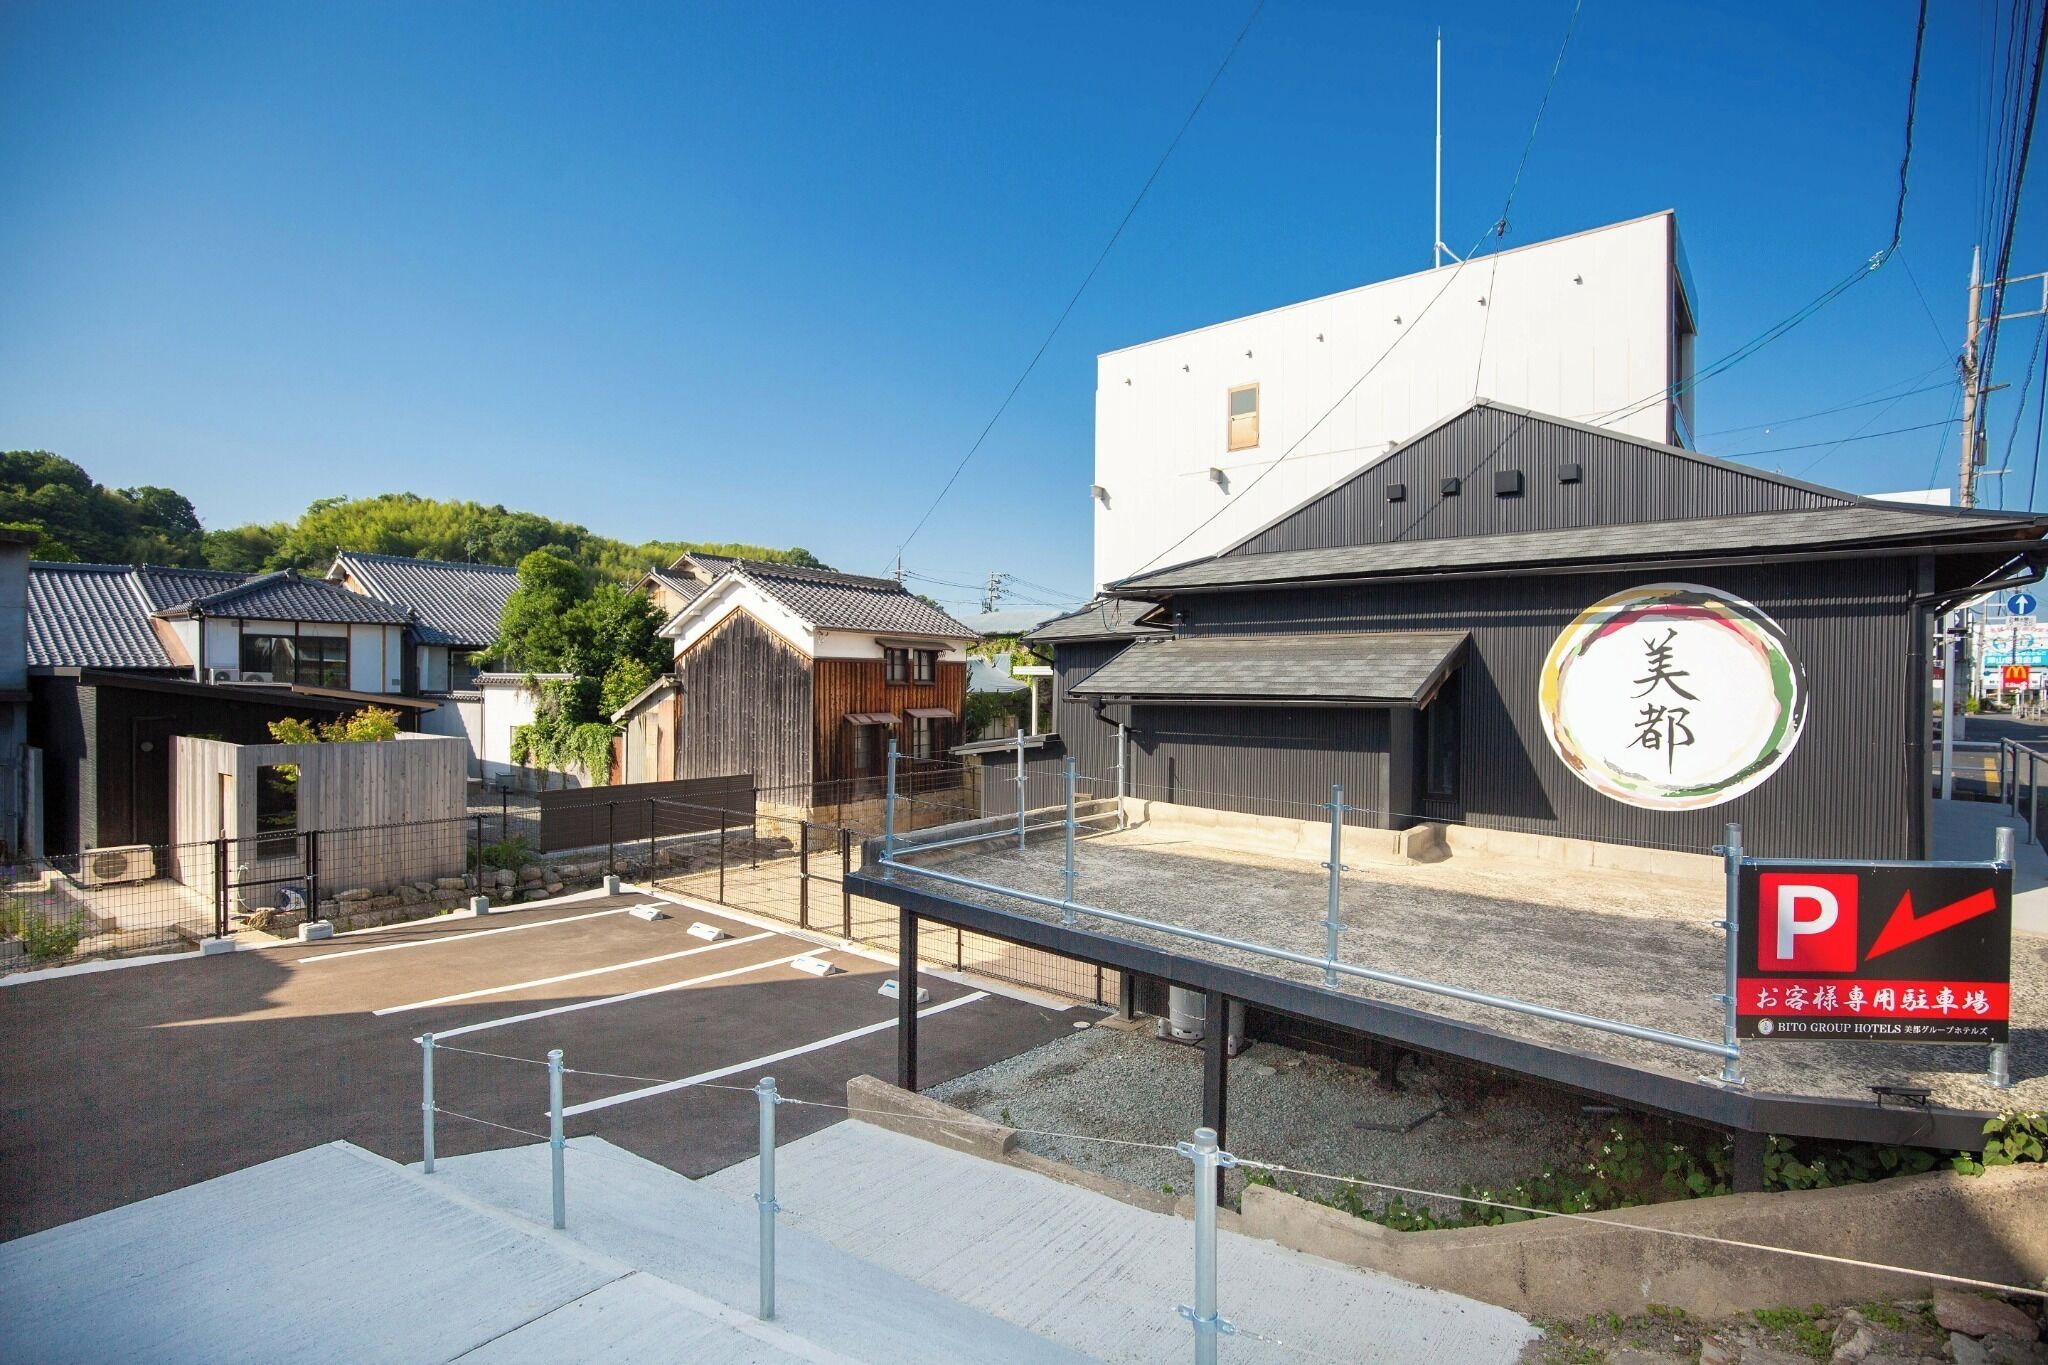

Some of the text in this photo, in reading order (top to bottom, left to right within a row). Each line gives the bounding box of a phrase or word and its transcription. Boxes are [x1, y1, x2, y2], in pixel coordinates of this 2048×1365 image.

[1626, 627, 1701, 774] 美都
[1776, 884, 1839, 960] P
[1756, 984, 1990, 1015] お客様専用駐車場
[1777, 1022, 1807, 1032] BITO
[1810, 1022, 1852, 1033] GROUP
[1854, 1023, 1902, 1034] HOTELS
[1904, 1024, 1989, 1036] 美都グループホテルズ
